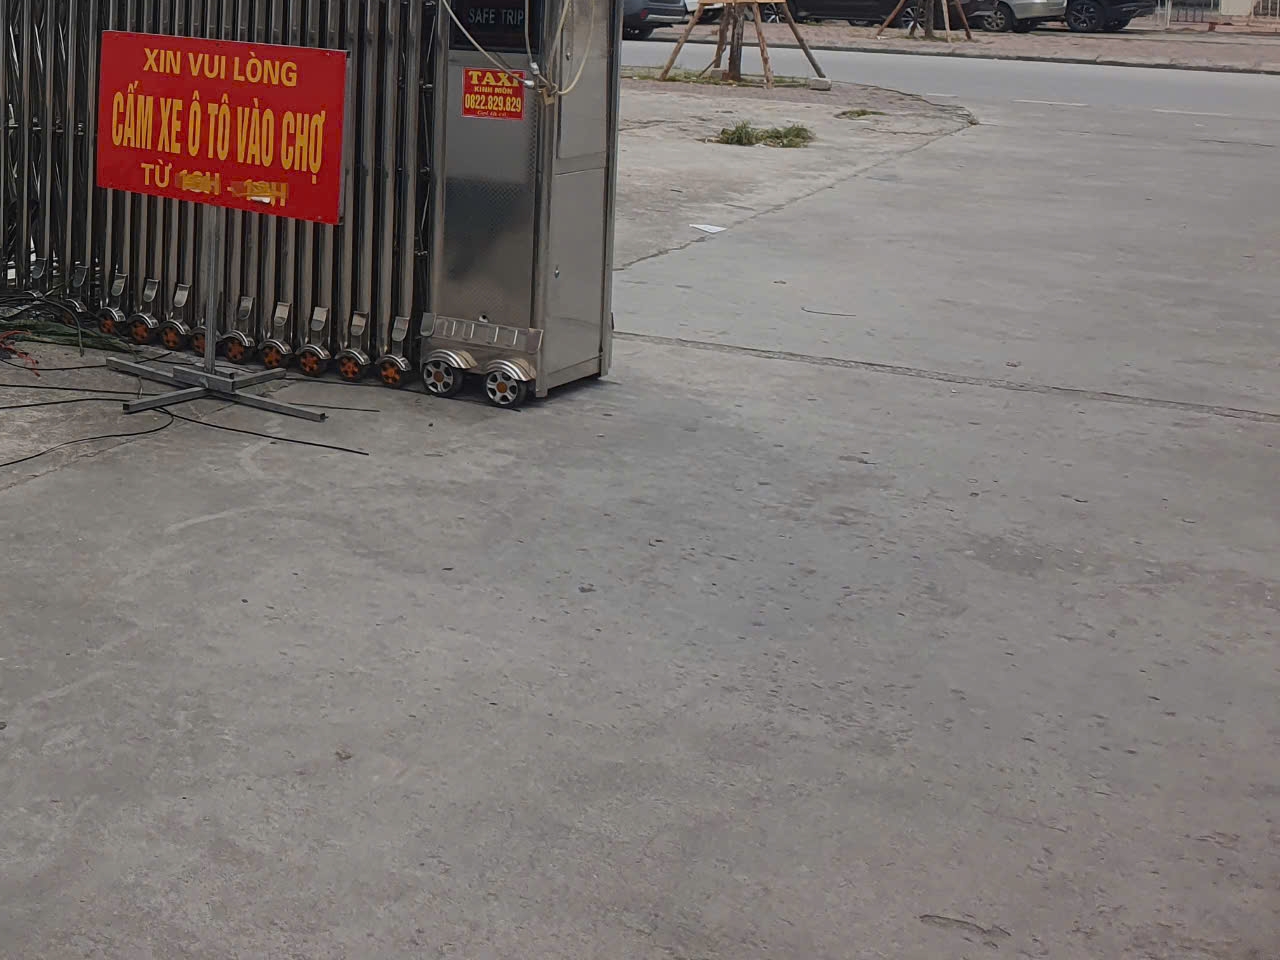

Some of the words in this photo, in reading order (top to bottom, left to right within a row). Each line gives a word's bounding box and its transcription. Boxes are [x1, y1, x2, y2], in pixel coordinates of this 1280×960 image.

[469, 8, 495, 24] SAFE
[502, 9, 524, 25] TRIP
[143, 47, 181, 75] XIN
[189, 52, 226, 80] VUI
[233, 51, 297, 87] LÒNG
[468, 70, 520, 87] TAXI
[465, 94, 522, 112] 0822.829.829
[112, 80, 153, 150] CẤM
[158, 97, 183, 154] XE
[188, 90, 201, 156] Ô
[207, 93, 230, 161] TÔ
[237, 98, 274, 167] VÀO
[281, 110, 326, 184] CHỢ
[141, 159, 172, 188] TỪ
